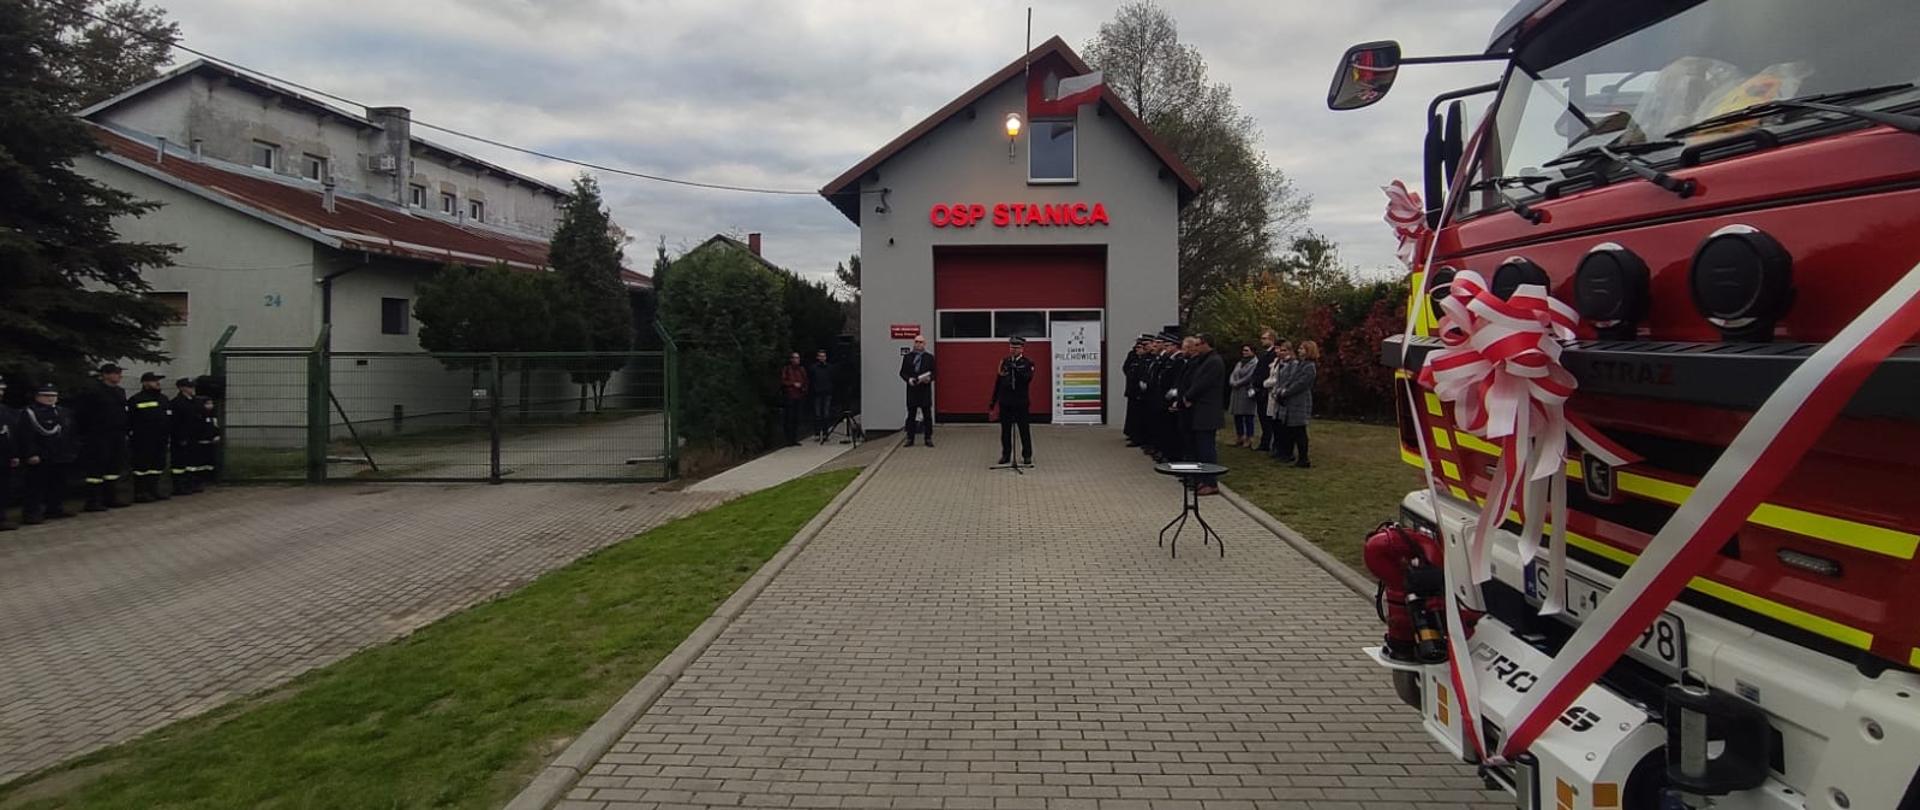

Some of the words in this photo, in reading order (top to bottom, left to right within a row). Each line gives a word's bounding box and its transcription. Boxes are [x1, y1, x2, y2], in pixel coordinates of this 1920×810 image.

[930, 203, 986, 227] OSP
[992, 202, 1109, 227] STANICA
[264, 294, 281, 307] 24
[1055, 352, 1097, 361] PILCHOWICE
[1538, 567, 1578, 616] SL
